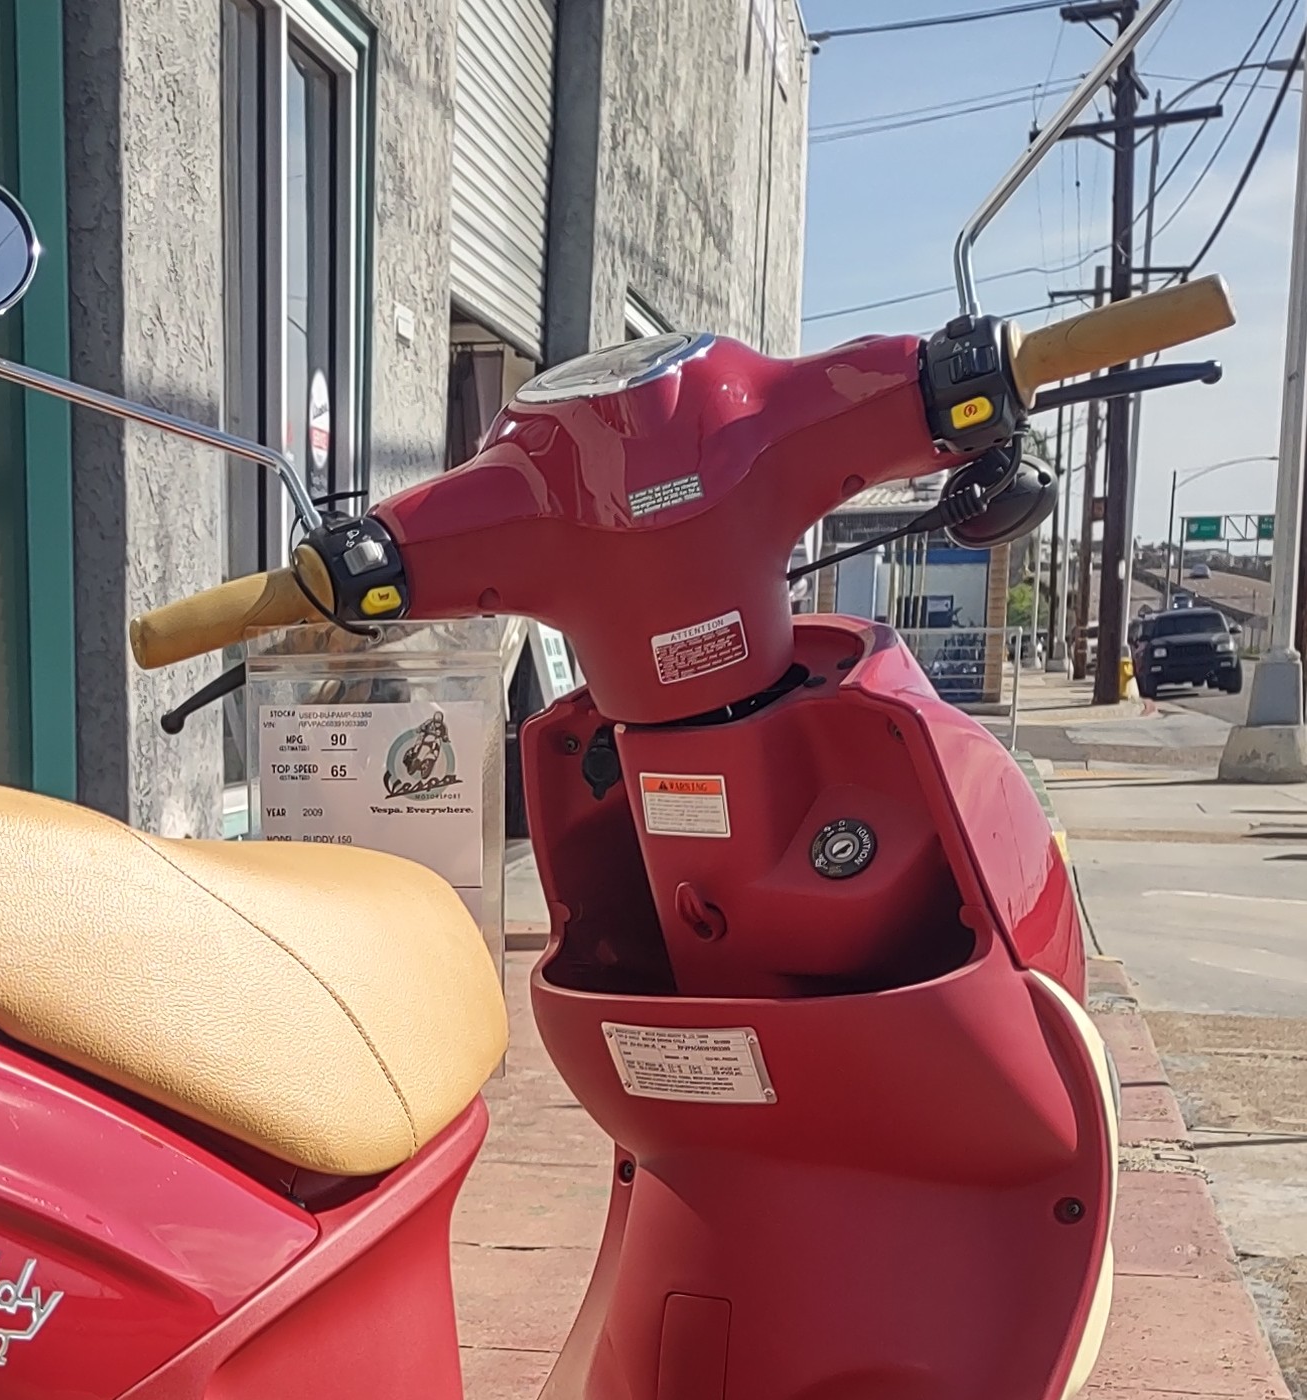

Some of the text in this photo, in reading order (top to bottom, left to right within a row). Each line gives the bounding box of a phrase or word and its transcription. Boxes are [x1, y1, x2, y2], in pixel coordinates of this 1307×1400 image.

[670, 619, 724, 642] ATTENTION
[286, 733, 347, 746] MPG 90
[271, 763, 347, 777] TOP SPEED 65
[383, 770, 464, 799] Vespa
[669, 782, 708, 792] WARNING
[266, 808, 323, 817] YEAR 2009
[369, 806, 474, 815] Vespa. Everywhere.
[854, 826, 871, 865] IGNITION
